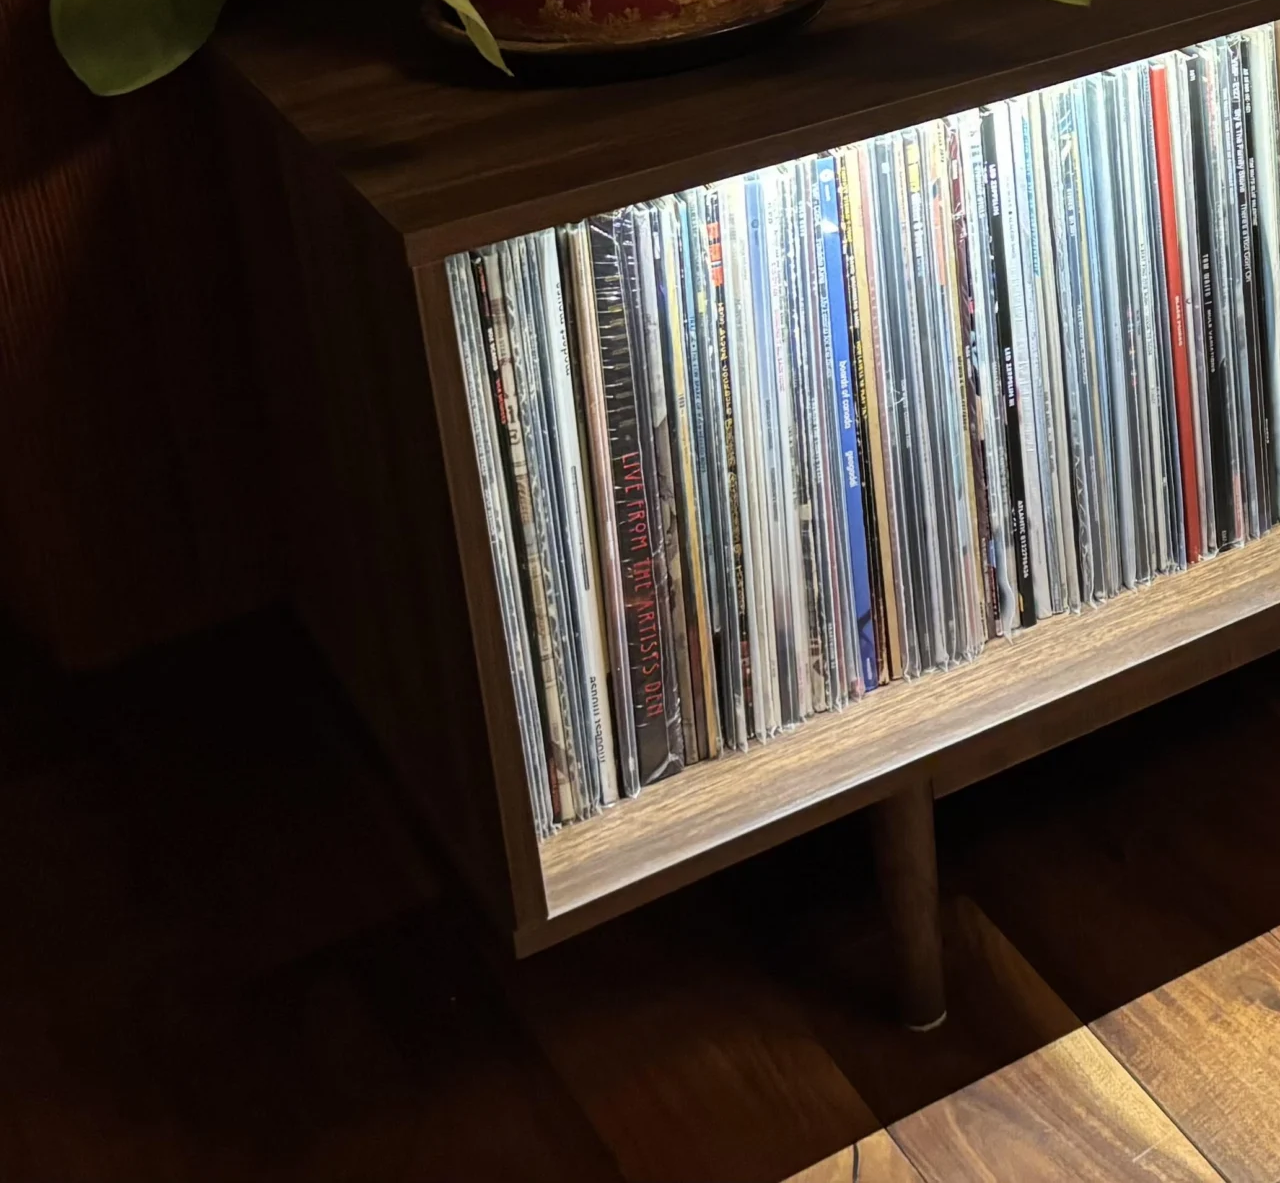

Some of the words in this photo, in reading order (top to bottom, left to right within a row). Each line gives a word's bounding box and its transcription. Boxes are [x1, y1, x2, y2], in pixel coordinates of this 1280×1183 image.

[1232, 108, 1241, 120] Sly
[1234, 121, 1241, 129] &
[1235, 144, 1244, 169] Family
[990, 179, 999, 216] ZEPPELIN
[1238, 170, 1246, 193] Stone
[1003, 347, 1011, 361] LED
[838, 360, 849, 388] boards
[1005, 362, 1014, 397] ZEPPELIN
[841, 389, 850, 398] of
[842, 399, 852, 428] canada
[621, 451, 641, 493] LIVE
[844, 450, 857, 487] geogaddi
[626, 499, 648, 551] FROM
[1016, 499, 1025, 534] ATLANTIC
[633, 557, 653, 591] THE
[637, 596, 661, 676] ARTISTS
[644, 682, 664, 718] DEN
